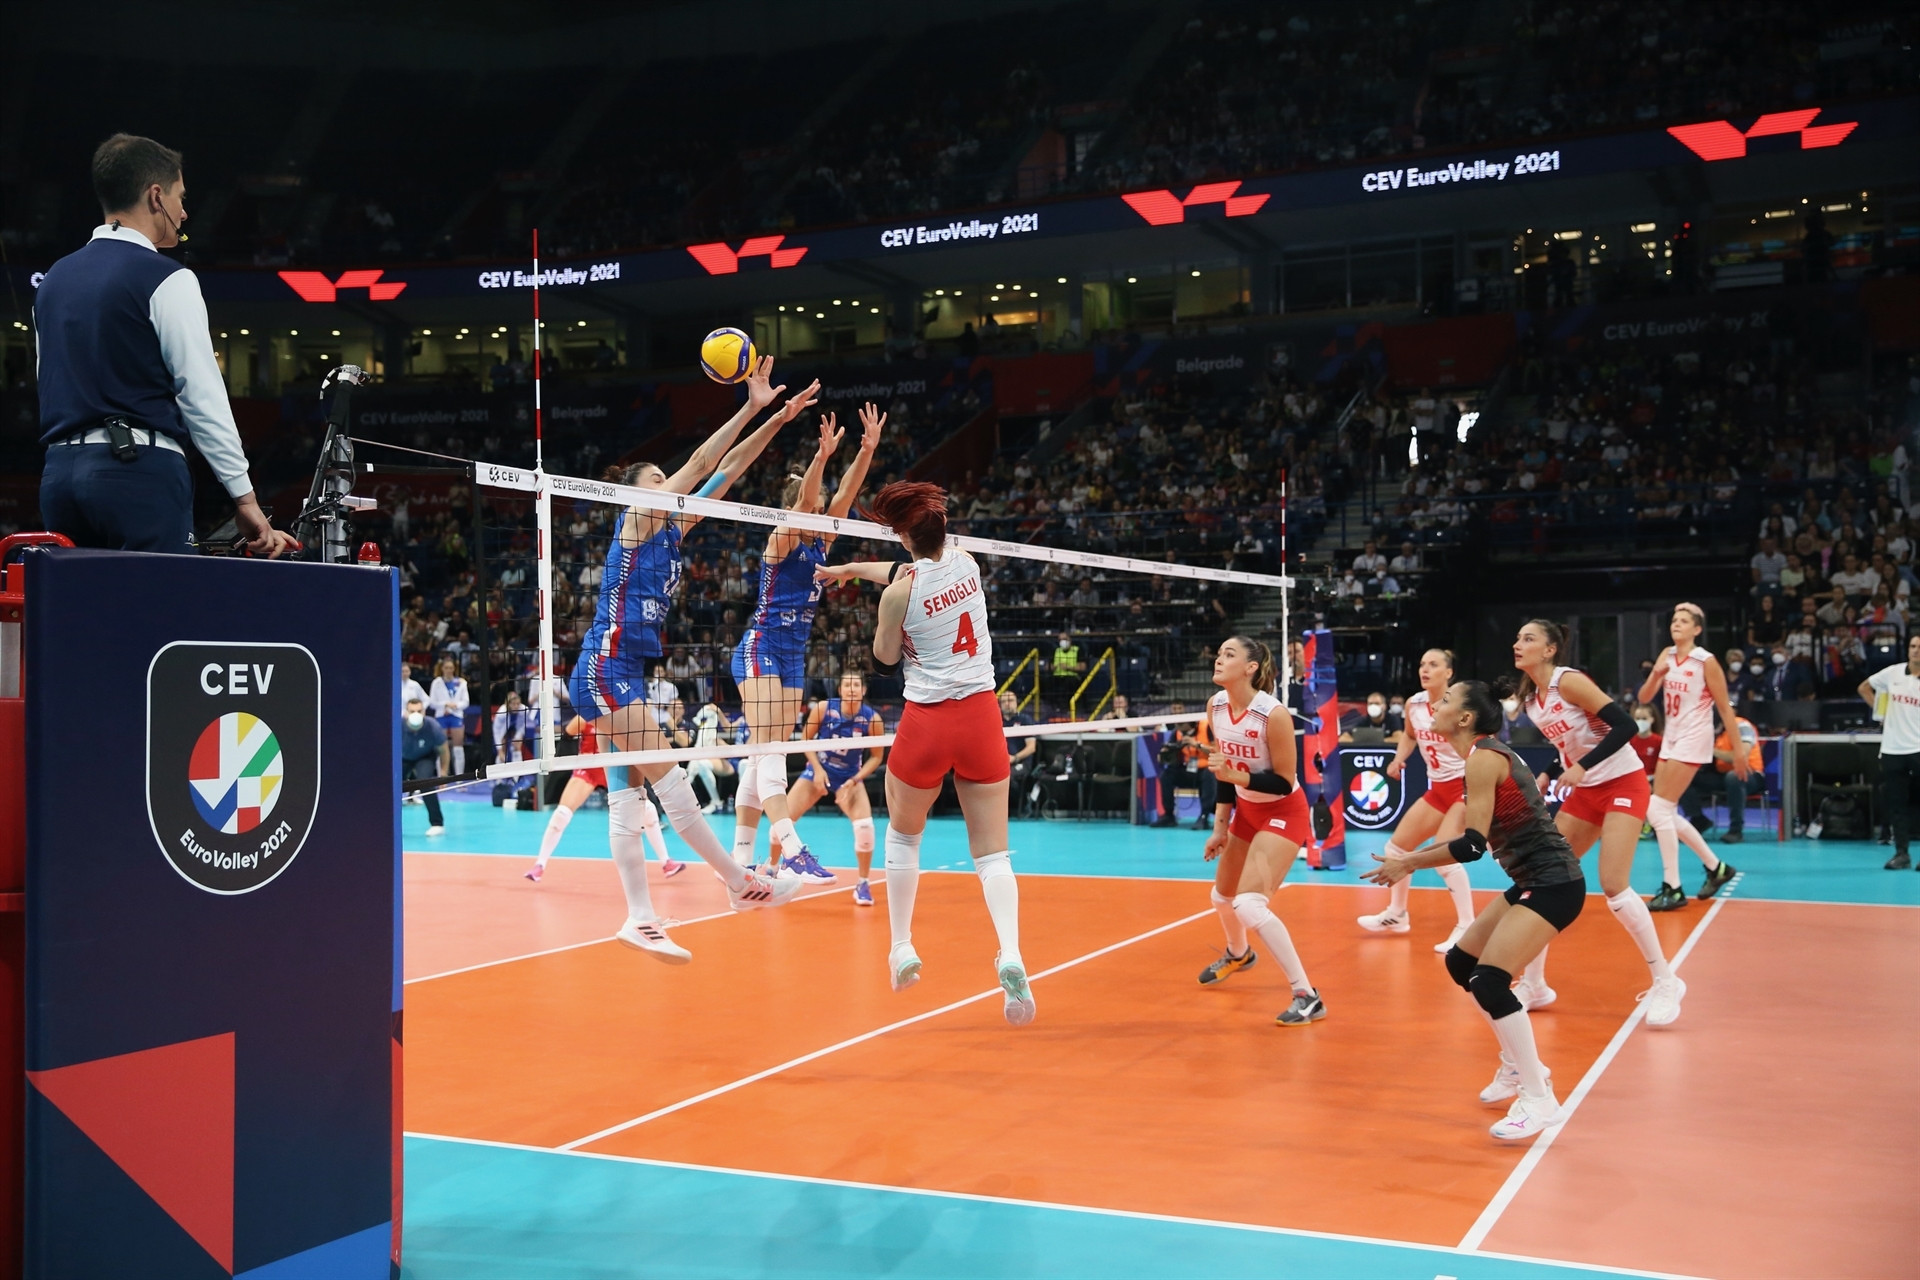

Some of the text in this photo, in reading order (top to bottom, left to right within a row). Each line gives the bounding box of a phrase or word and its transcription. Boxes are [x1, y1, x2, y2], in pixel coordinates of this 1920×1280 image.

[1362, 150, 1560, 192] CEV EuroVolley 2021
[880, 212, 1038, 248] CEV EuroVolley 2021
[479, 262, 620, 288] CEV EuroVolley 2021
[1603, 323, 1642, 340] CEV
[1176, 354, 1244, 375] Belgrade
[825, 380, 926, 399] EuroVolley 2021
[360, 408, 489, 425] CEV EuroVolley 2021
[551, 404, 608, 420] Belgrade
[501, 471, 520, 482] CEV
[553, 479, 616, 497] CEV EuroVolley 2021
[740, 507, 751, 516] CEV
[751, 509, 776, 520] EuroVolley
[923, 577, 977, 619] ŞENOĞLU
[952, 611, 979, 658] 4
[200, 662, 275, 696] CEV
[1543, 719, 1574, 739] ESTEL
[1353, 755, 1384, 768] CEV
[1426, 745, 1440, 769] 3
[179, 820, 293, 870] EuroVolley 2021
